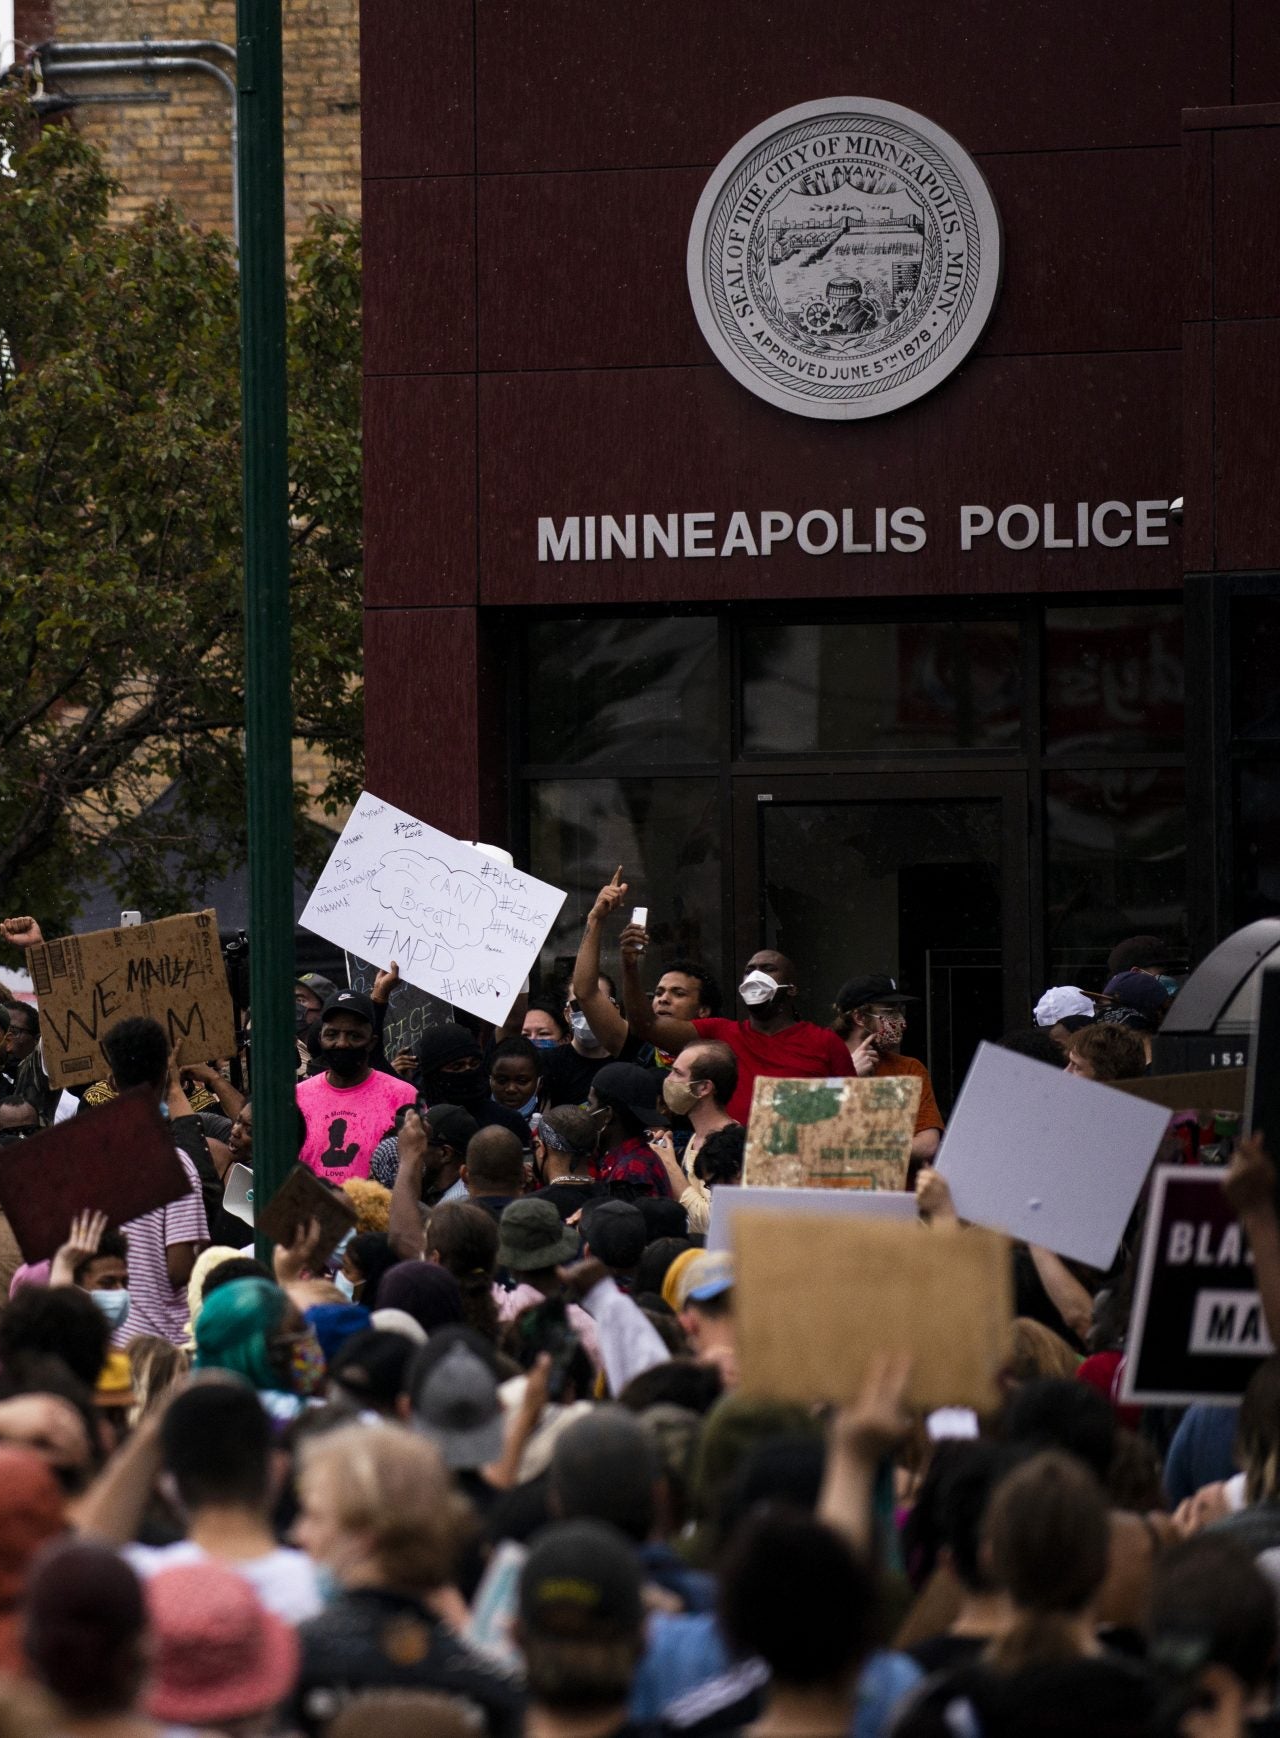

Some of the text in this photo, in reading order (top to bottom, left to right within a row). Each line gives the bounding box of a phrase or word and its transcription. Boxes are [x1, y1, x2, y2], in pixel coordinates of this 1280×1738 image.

[802, 165, 887, 186] EN AVANT
[726, 136, 963, 318] SEAL OF THE CITY OF MINNEAPOLIS, MINN.
[752, 330, 827, 379] APPROVED
[831, 363, 871, 380] JUNE
[899, 329, 931, 361] 1878
[537, 499, 1170, 562] MINNEAPOLIS POLICE
[400, 886, 469, 936] Breath
[363, 922, 454, 972] #MPD
[43, 967, 122, 1053] WE
[1165, 1219, 1256, 1268] BLA
[1207, 1304, 1261, 1343] MA
